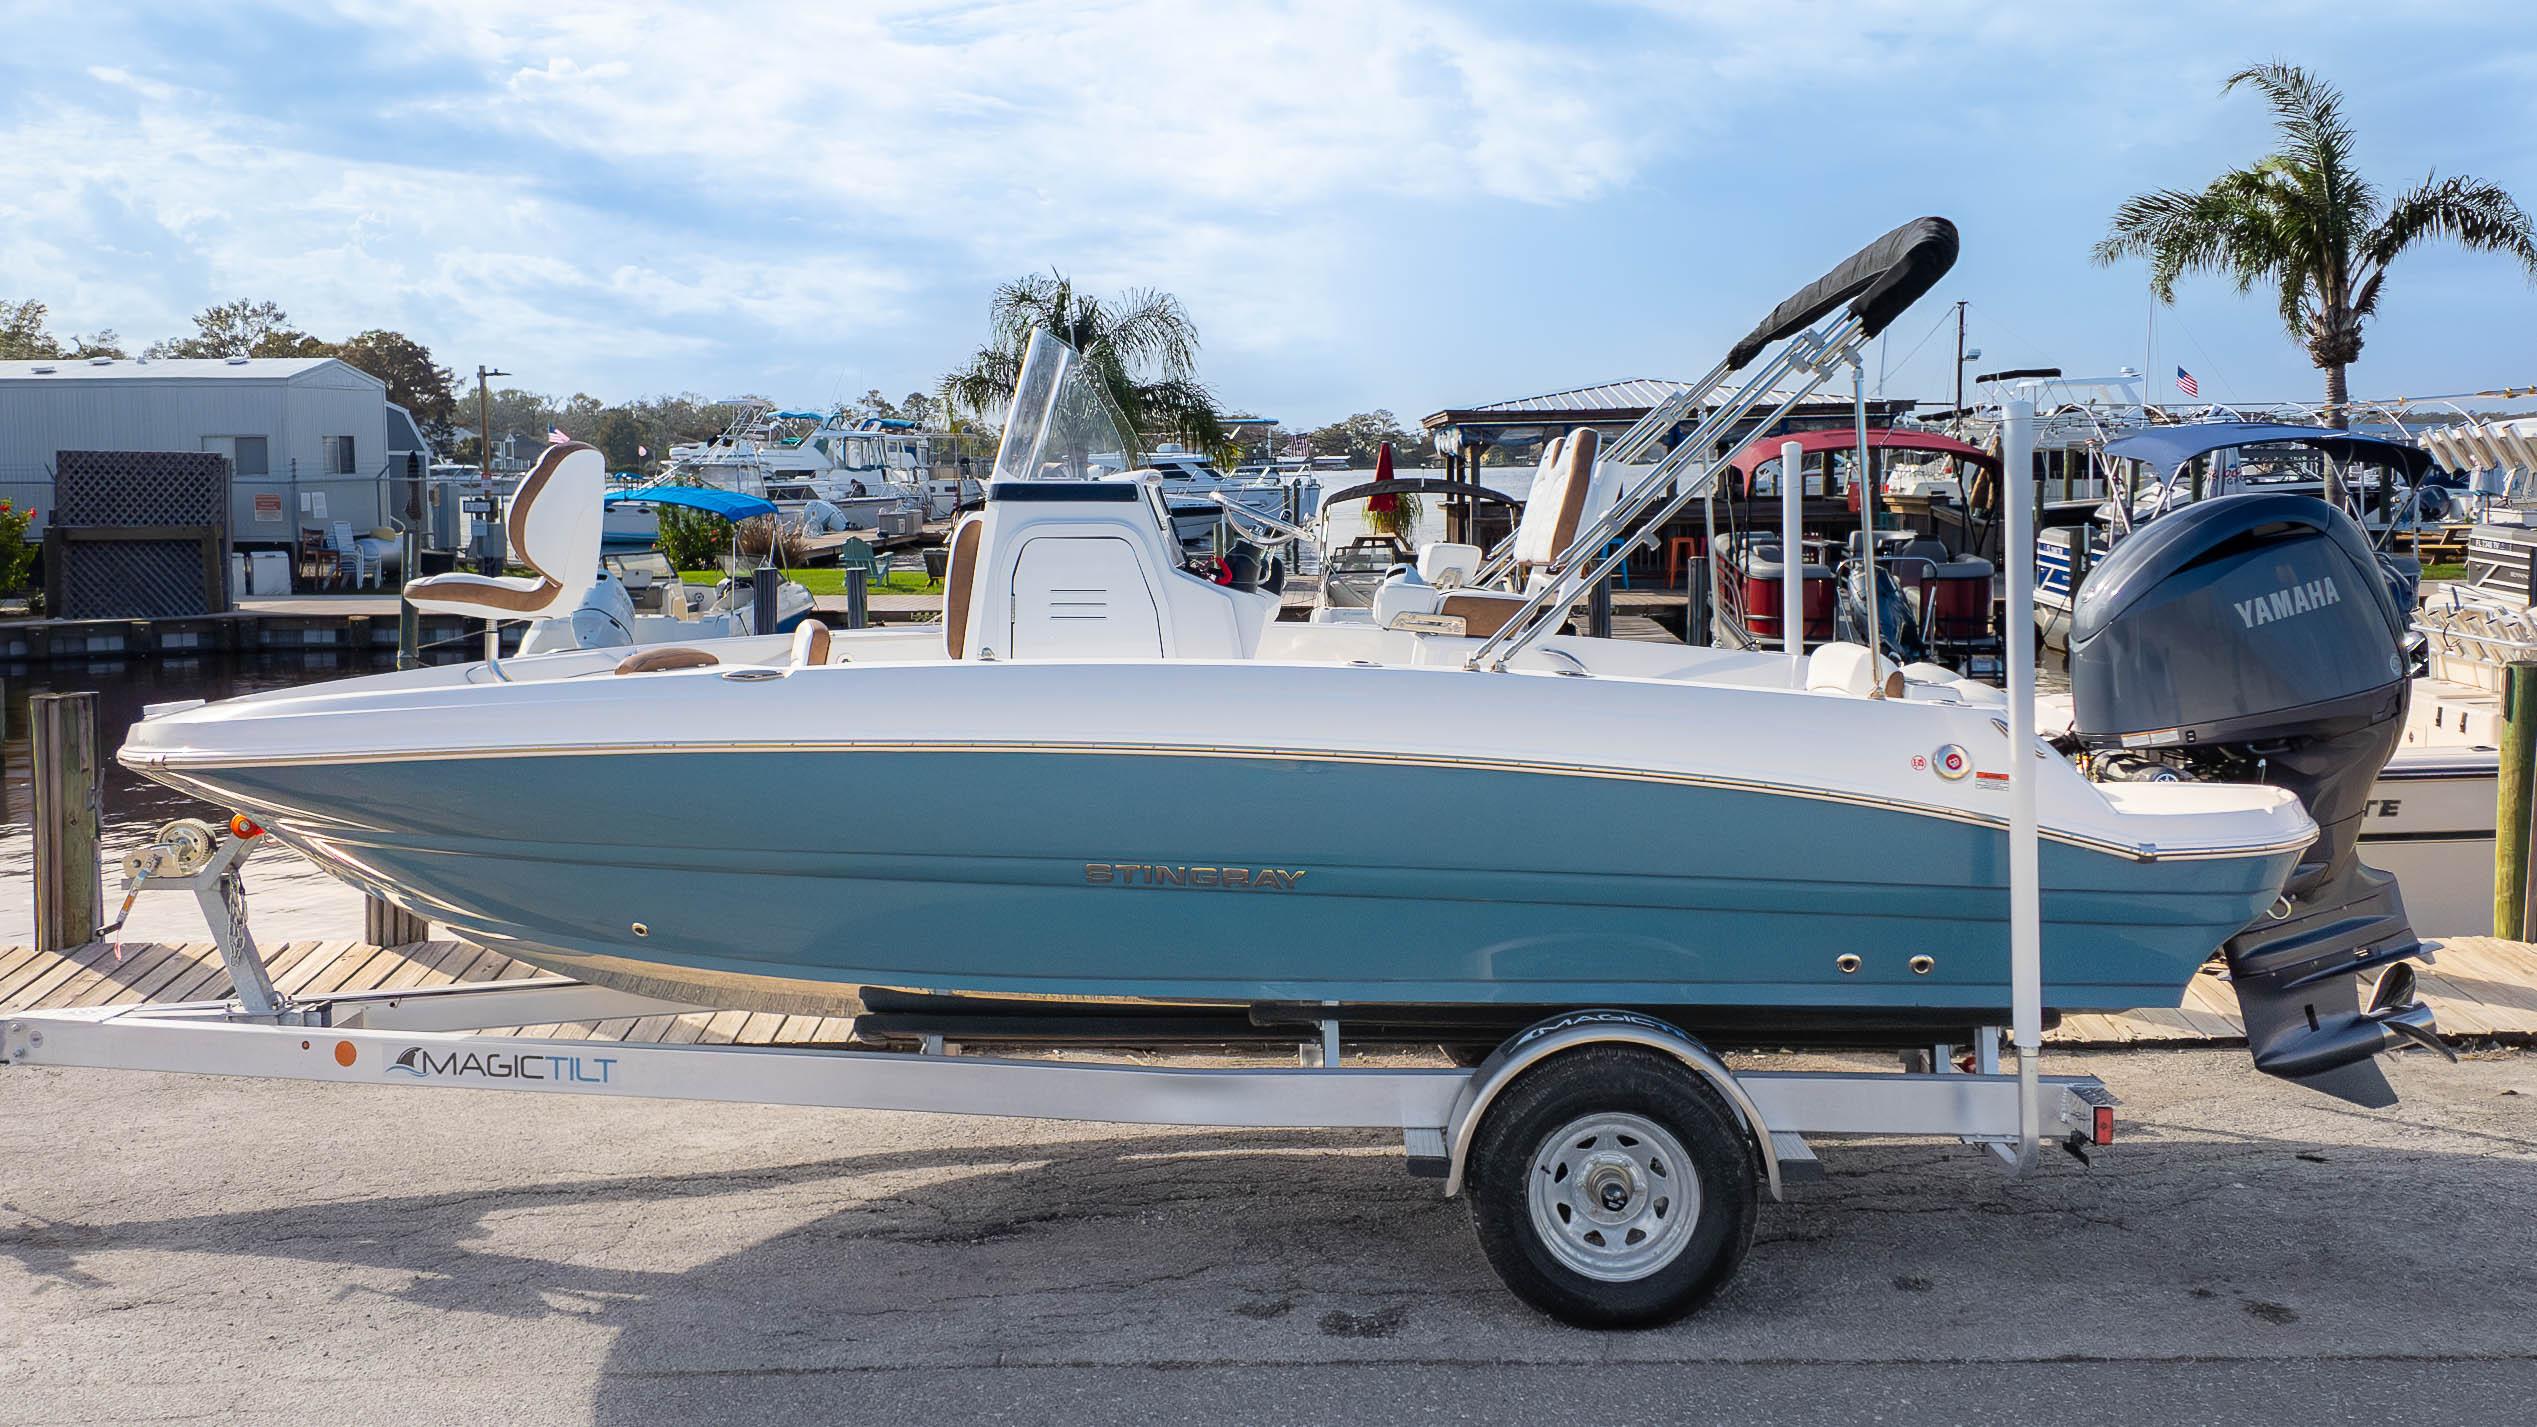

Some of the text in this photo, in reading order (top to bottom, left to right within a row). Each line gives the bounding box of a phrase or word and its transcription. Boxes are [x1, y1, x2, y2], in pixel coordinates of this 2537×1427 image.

[2233, 577, 2341, 628] YAMAHA
[1085, 863, 1306, 890] STINGRAY
[421, 1051, 618, 1083] MAGICTILT
